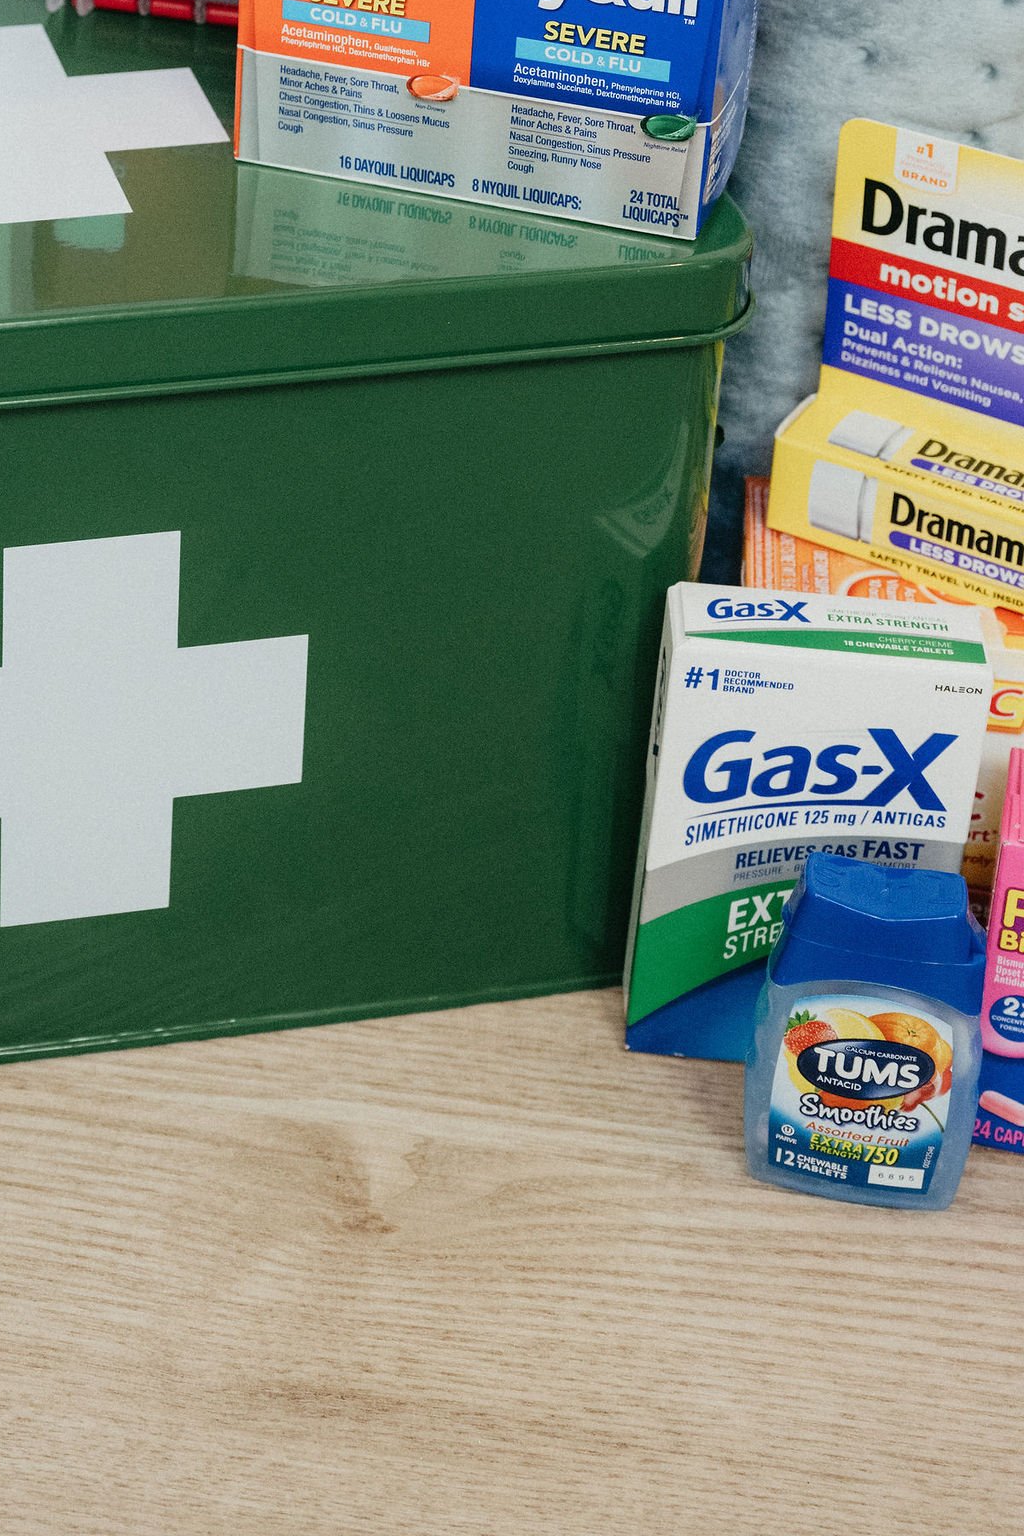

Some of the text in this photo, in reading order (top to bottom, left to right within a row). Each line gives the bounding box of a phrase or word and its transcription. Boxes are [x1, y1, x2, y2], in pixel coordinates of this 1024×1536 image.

[310, 8, 402, 34] COLD & FLU
[281, 24, 372, 50] Acetaminophen,
[544, 21, 646, 54] SEVERE
[545, 46, 641, 73] COLD & FLU
[280, 65, 399, 94] Headache, Fever, Sore Throat,
[514, 63, 608, 89] Acetaminophen,
[278, 121, 304, 133] Cough
[917, 144, 934, 158] #1
[339, 156, 455, 187] 16 DAYQUIL LIQUICAPS
[902, 170, 948, 189] BRAND
[472, 179, 582, 210] 8 NYQUIL LIQUICAPS:
[630, 190, 680, 211] 24 TOTAL
[879, 264, 998, 315] motion
[845, 294, 912, 331] LESS
[844, 321, 963, 369] Dual Action:
[842, 337, 898, 366] Prevents
[901, 353, 910, 367] &
[914, 359, 967, 386] Relieves
[841, 351, 991, 407] Dizziness and Vomiting
[890, 492, 1024, 566] Dramam
[910, 539, 954, 565] LESS
[870, 552, 912, 569] SAFETY
[916, 565, 959, 585] TRAVEL
[964, 582, 989, 597] VIAL
[707, 599, 811, 623] Gas-X
[827, 615, 872, 625] EXTRA
[876, 618, 949, 632] STRENGTH
[856, 641, 909, 652] CHEWABLE
[911, 646, 954, 656] TABLETS
[878, 636, 952, 648] CHERRY CREME
[684, 666, 719, 691] #1
[724, 677, 794, 690] RECOMMENDED
[725, 670, 761, 679] DOCTOR
[723, 685, 754, 695] BRAND
[935, 685, 983, 695] HALEON
[683, 728, 958, 812] Gas-X
[685, 811, 798, 846] SIMETHICONE
[804, 811, 829, 825] 125
[834, 811, 856, 826] mg
[872, 811, 946, 829] ANTIGAS
[736, 840, 924, 869] RELIEVES GAS FAST
[845, 1046, 917, 1062] CALCIUM CARBONATE
[814, 1047, 920, 1089] TUMS
[817, 1075, 861, 1091] ANTACID
[801, 1093, 917, 1131] Smoothies
[806, 1122, 909, 1147] Assorted Fruit
[810, 1133, 863, 1153] EXTRA
[776, 1148, 794, 1166] 12
[797, 1155, 848, 1172] CHEWABLE
[809, 1144, 861, 1160] STRENGTH
[864, 1145, 898, 1165] 750
[797, 1162, 847, 1179] TABLETS
